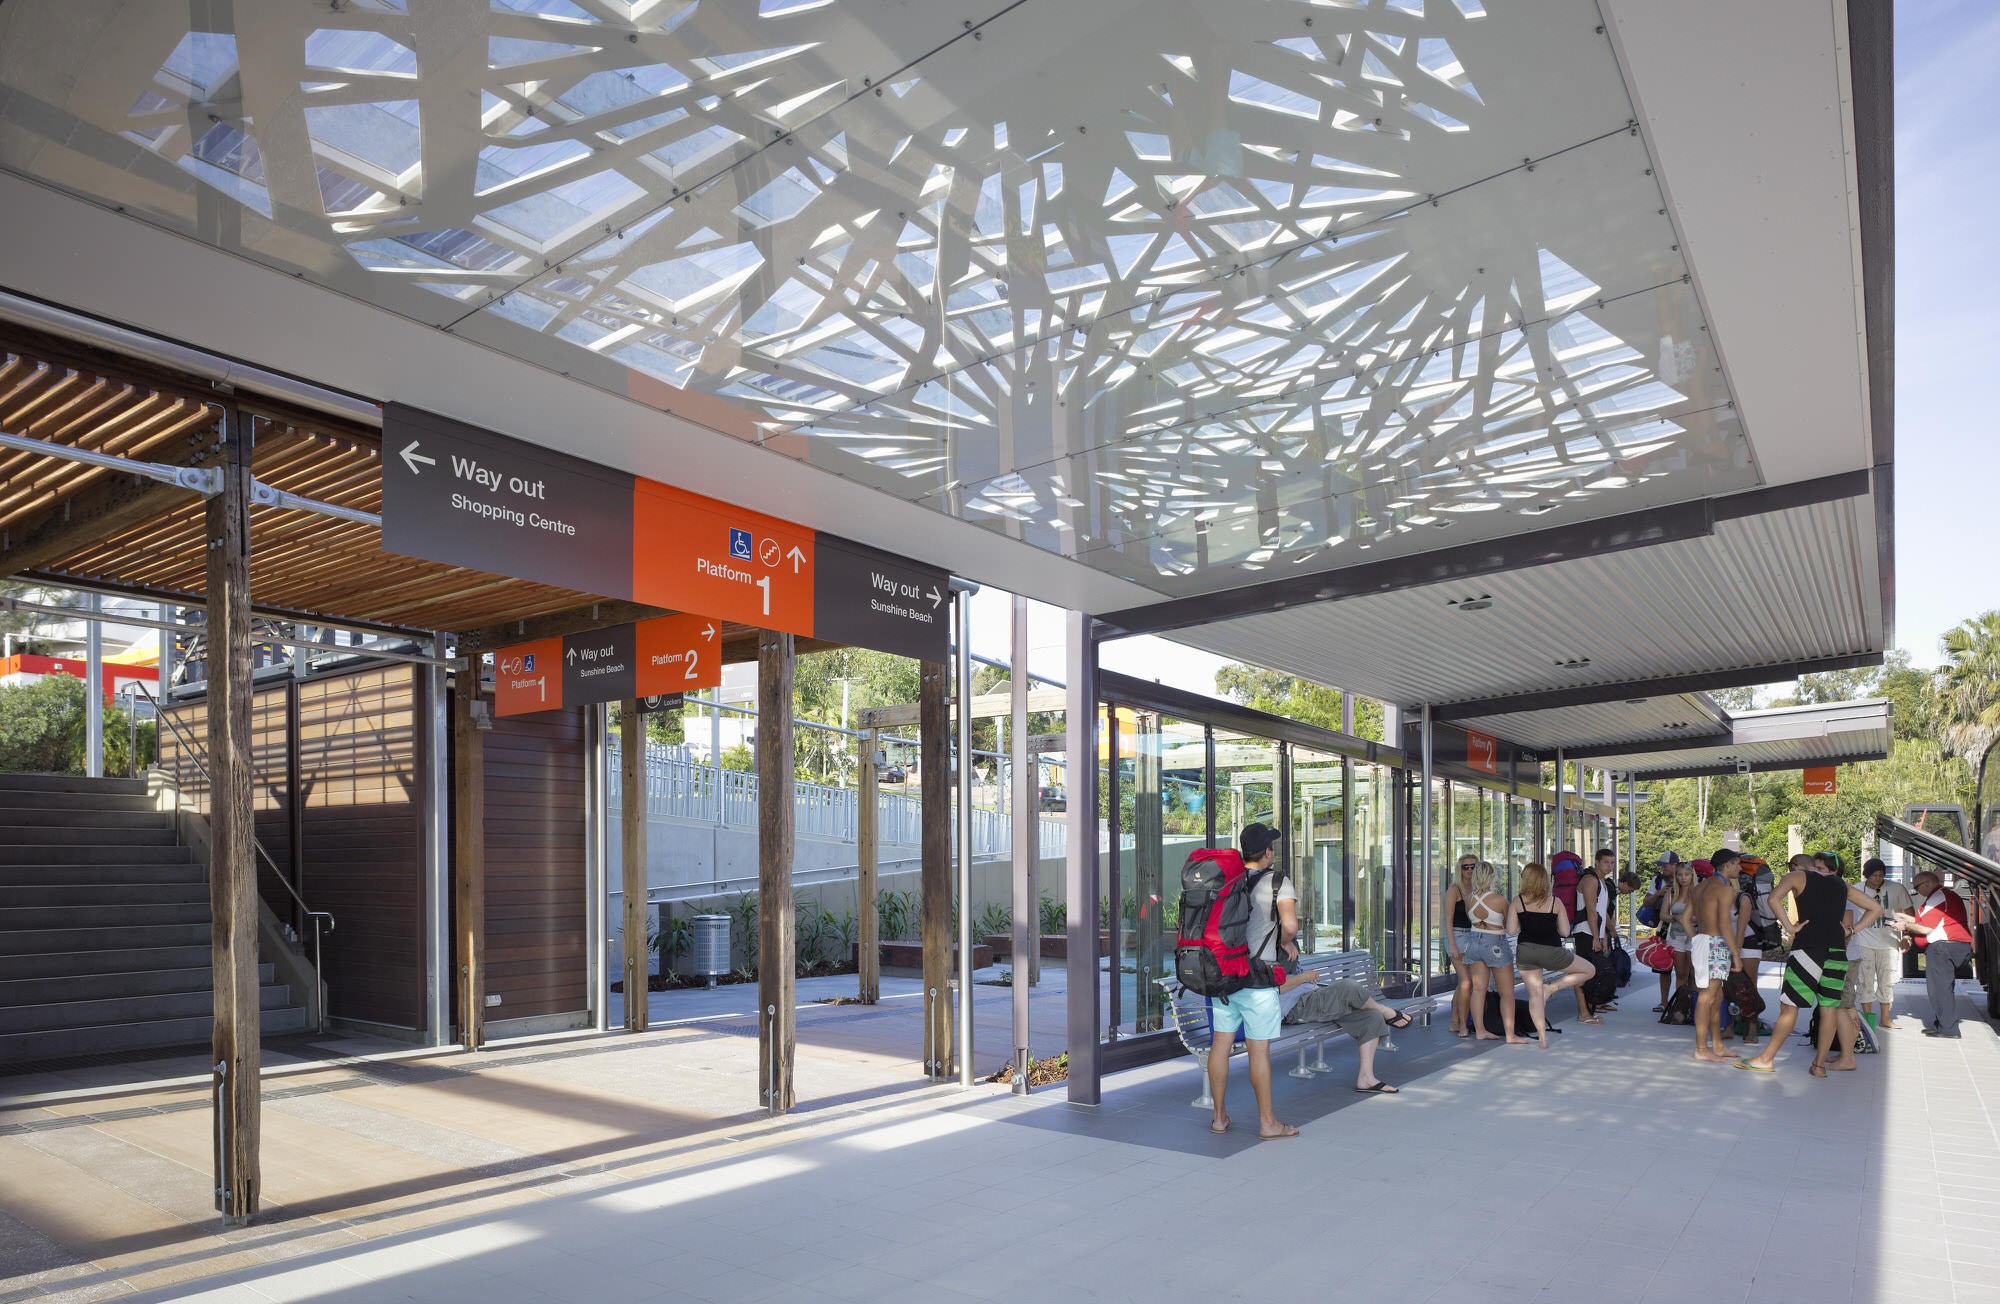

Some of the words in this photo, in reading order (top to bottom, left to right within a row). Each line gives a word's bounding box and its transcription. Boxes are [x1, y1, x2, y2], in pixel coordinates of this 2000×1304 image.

[451, 454, 503, 493] Way
[509, 477, 545, 500] out
[451, 493, 525, 527] Shopping
[529, 513, 576, 536] Centre
[697, 557, 752, 585] Platform
[756, 575, 770, 616] 1
[871, 571, 898, 597] Way
[901, 584, 920, 600] out
[871, 598, 908, 617] Sunshine
[909, 608, 933, 624] Beach
[580, 648, 599, 662] Way
[600, 644, 614, 658] out
[651, 653, 683, 666] Platform
[685, 649, 699, 680] 2
[580, 666, 606, 678] Sunshine
[606, 663, 625, 674] Beach
[511, 679, 537, 690] Platform
[538, 676, 546, 702] 1
[1486, 740, 1493, 769] 2
[1824, 781, 1833, 791] 2
